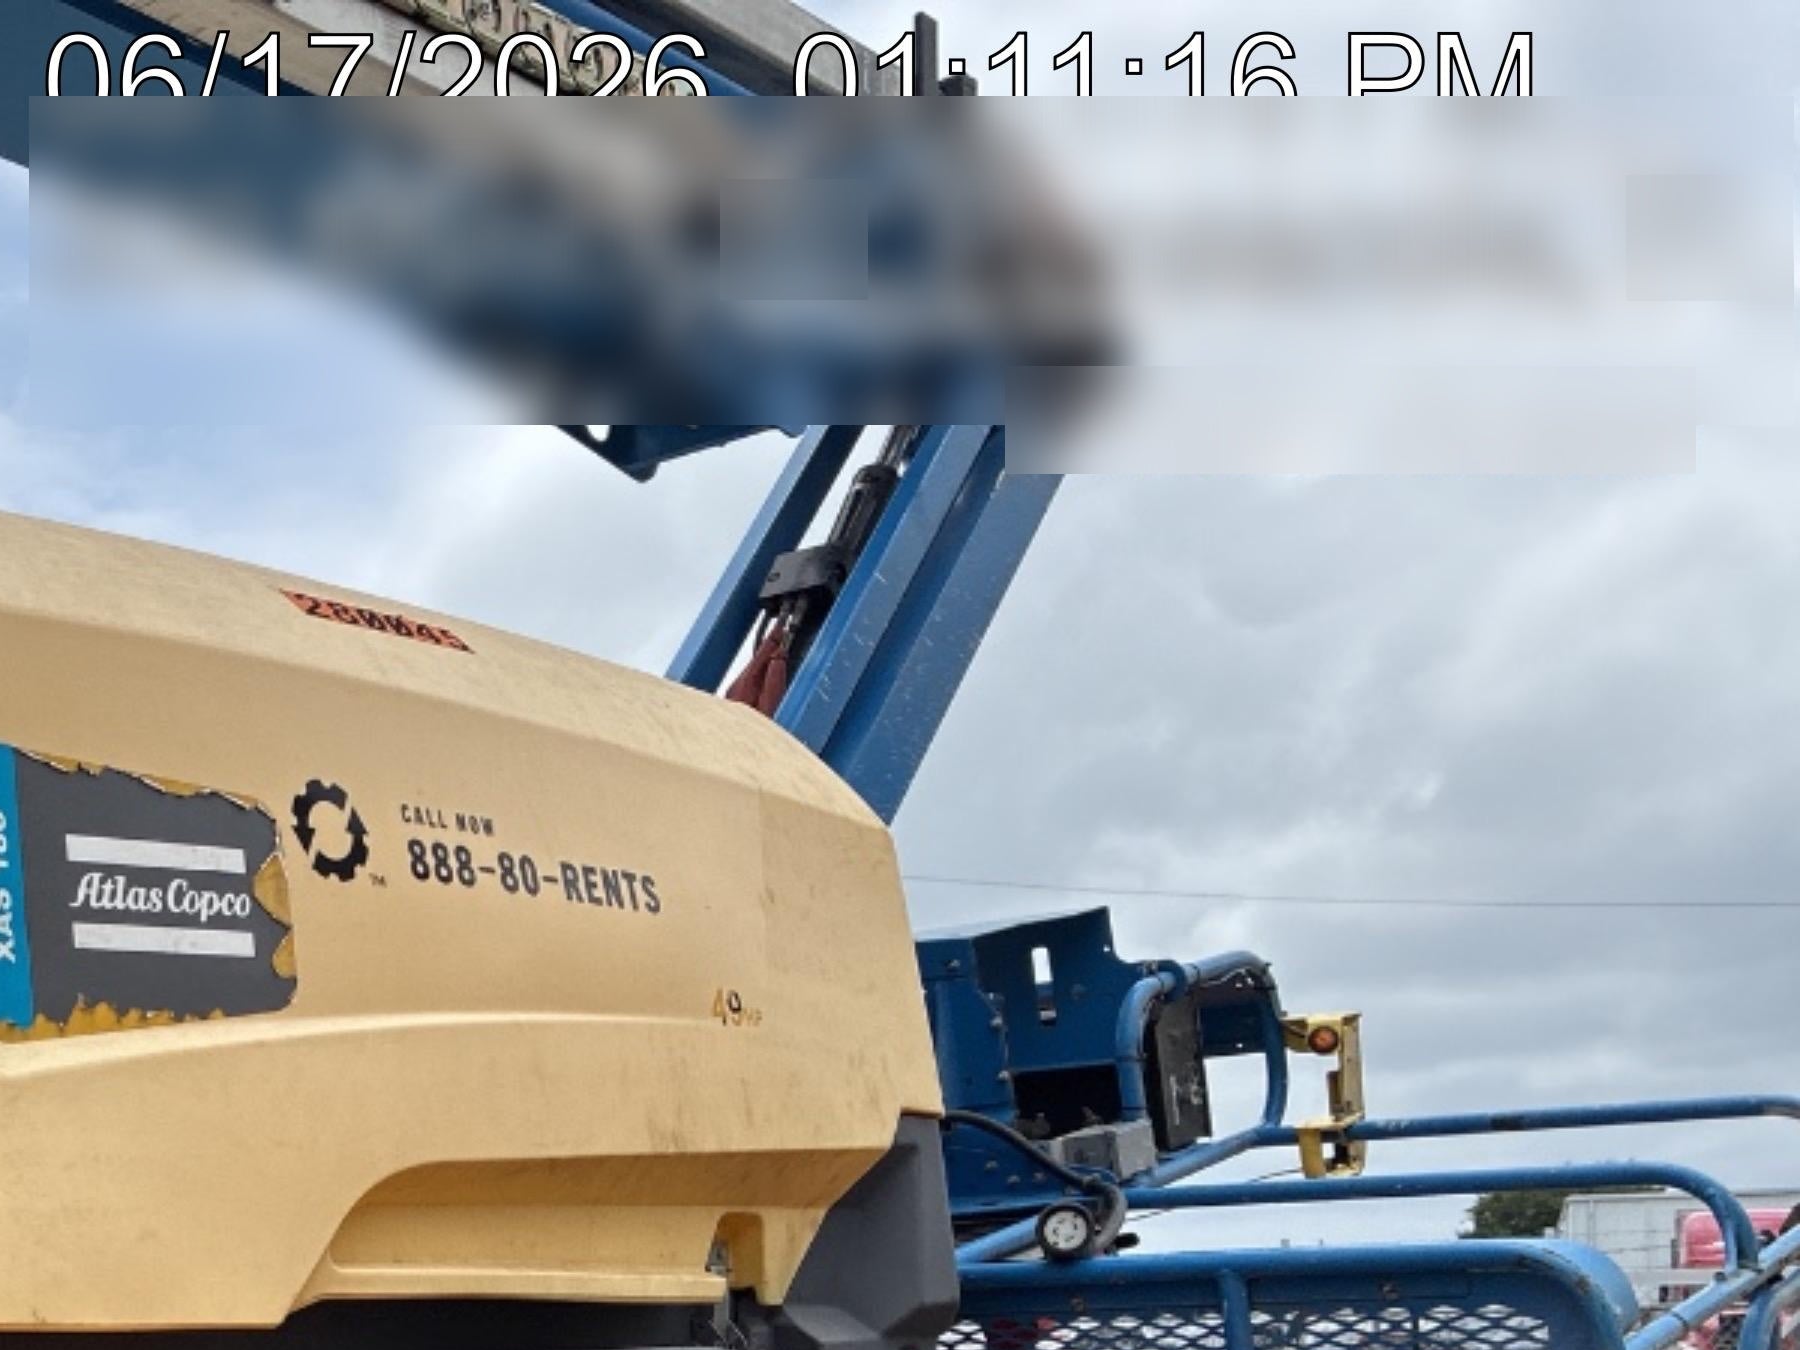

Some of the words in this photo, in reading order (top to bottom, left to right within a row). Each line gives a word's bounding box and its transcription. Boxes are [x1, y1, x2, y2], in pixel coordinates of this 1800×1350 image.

[400, 802, 448, 830] CALL
[455, 811, 495, 837] NOW
[68, 871, 164, 913] Atlas
[167, 878, 251, 923] Copco
[407, 837, 662, 914] 888-80-RENTS
